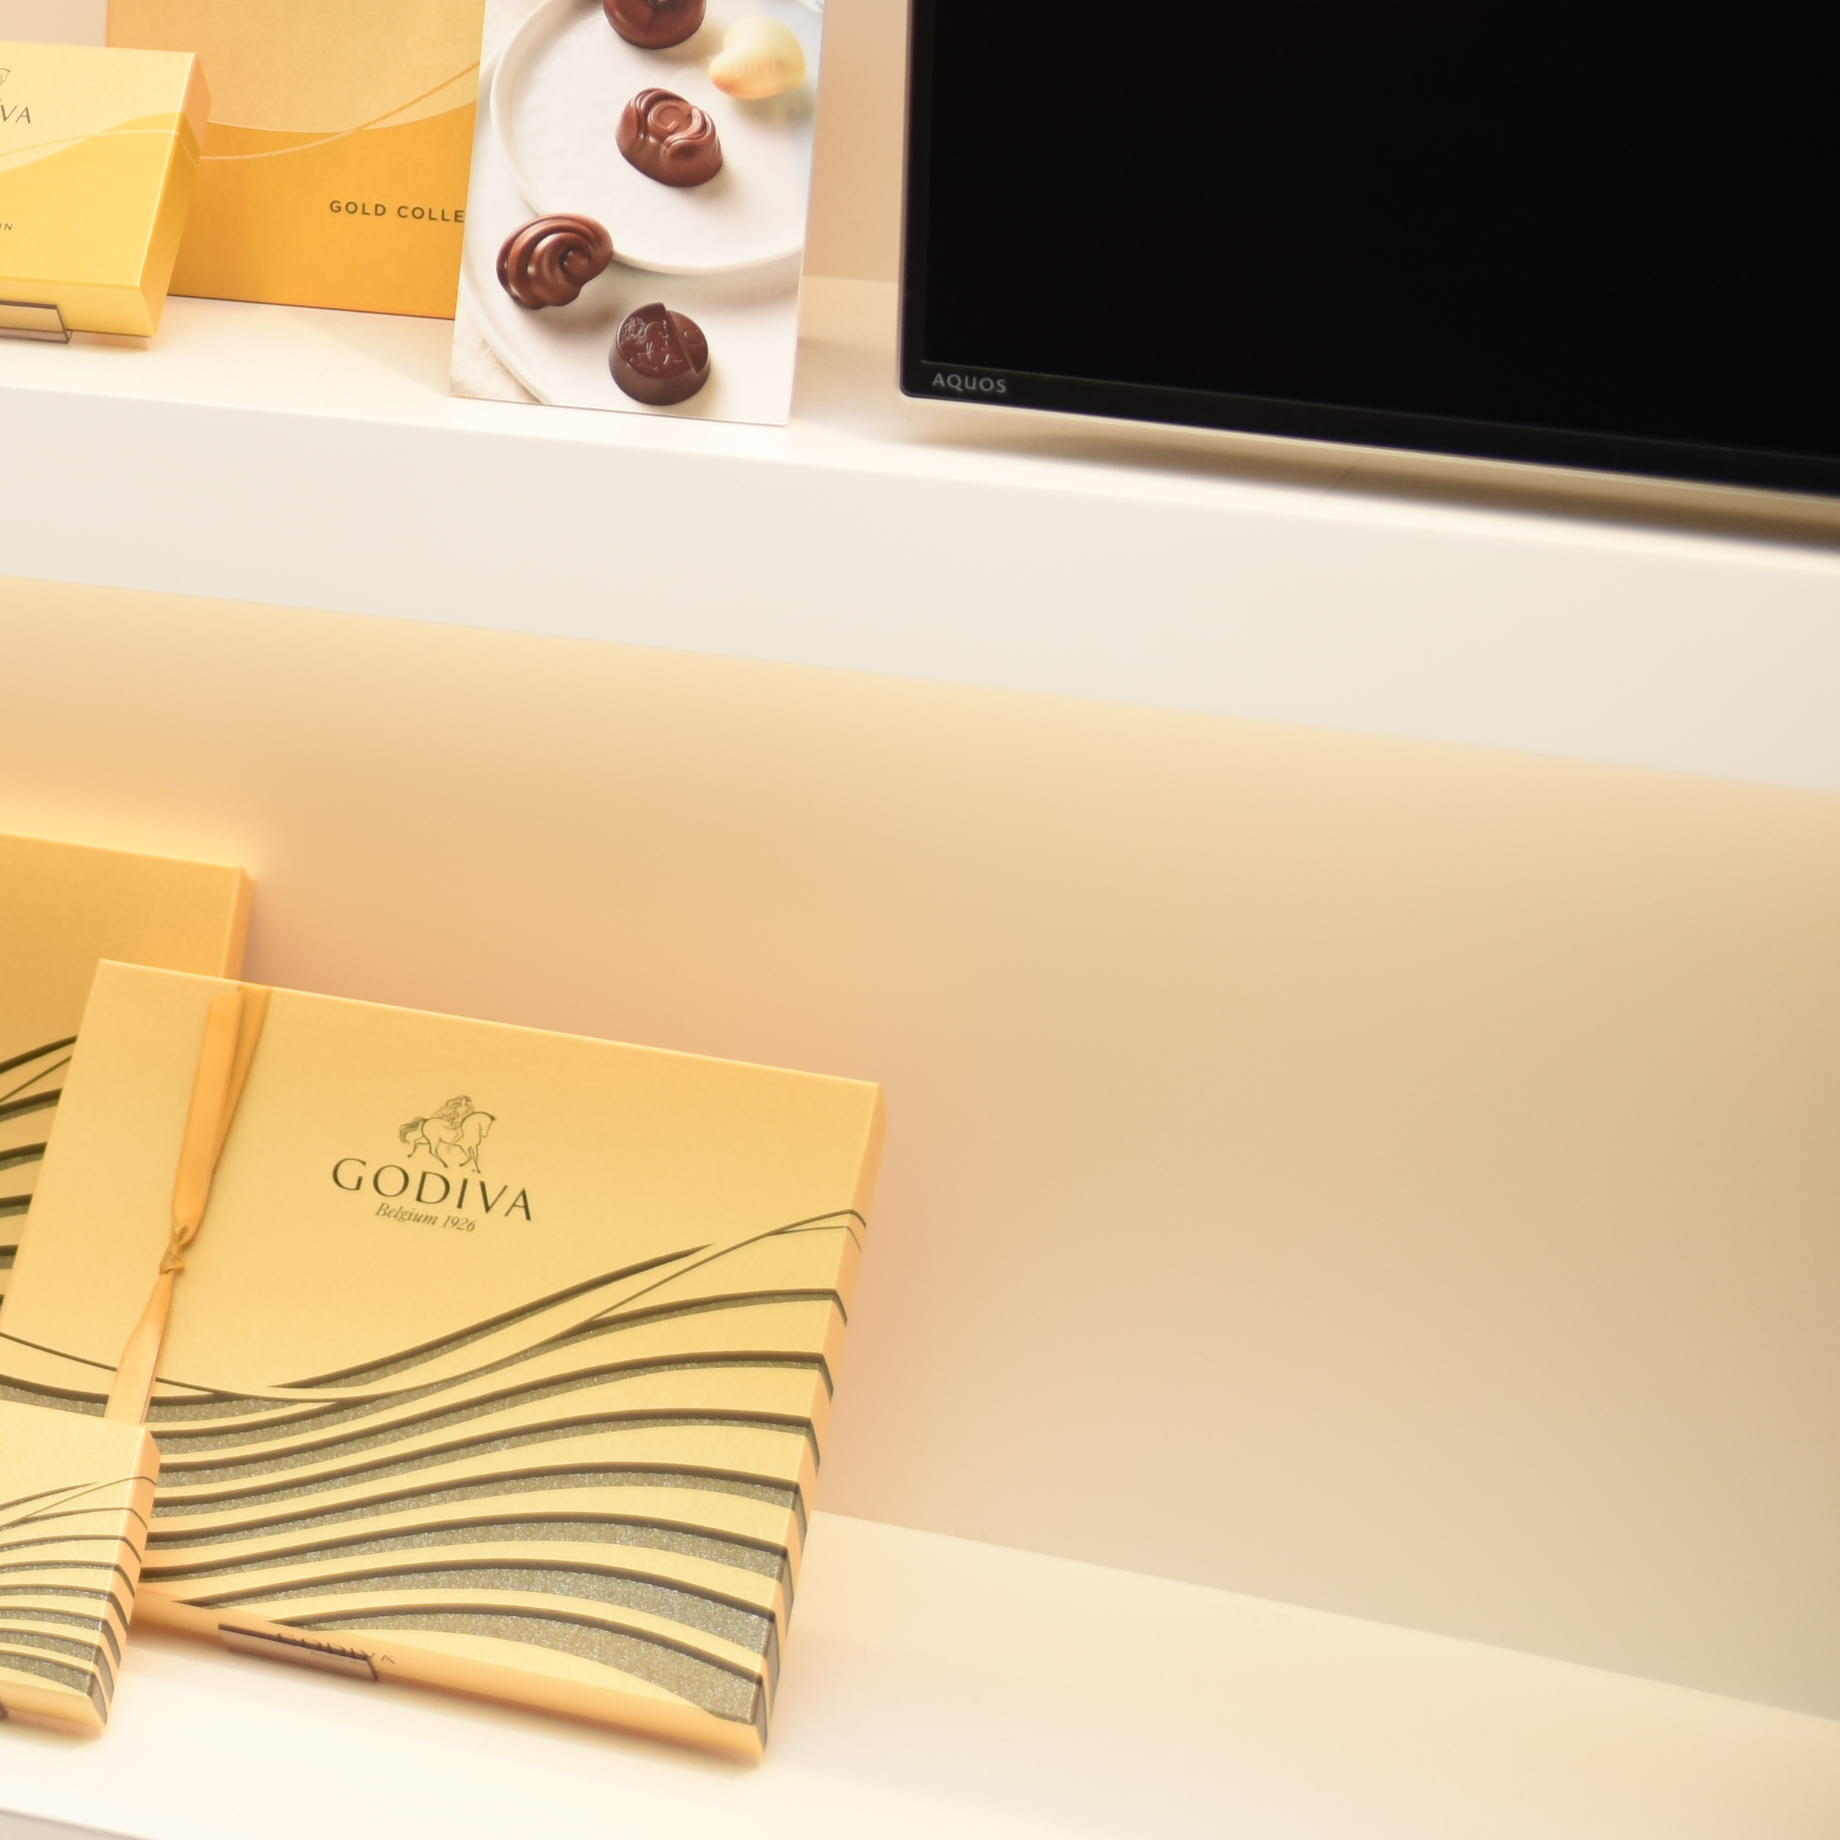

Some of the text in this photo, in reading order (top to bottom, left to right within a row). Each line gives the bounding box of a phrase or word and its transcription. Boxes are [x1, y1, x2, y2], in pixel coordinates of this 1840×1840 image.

[329, 199, 465, 223] GOLD COLLE
[932, 372, 1007, 393] AQUOS
[331, 1157, 532, 1222] GODIVA
[374, 1201, 477, 1233] Belgium 1926
